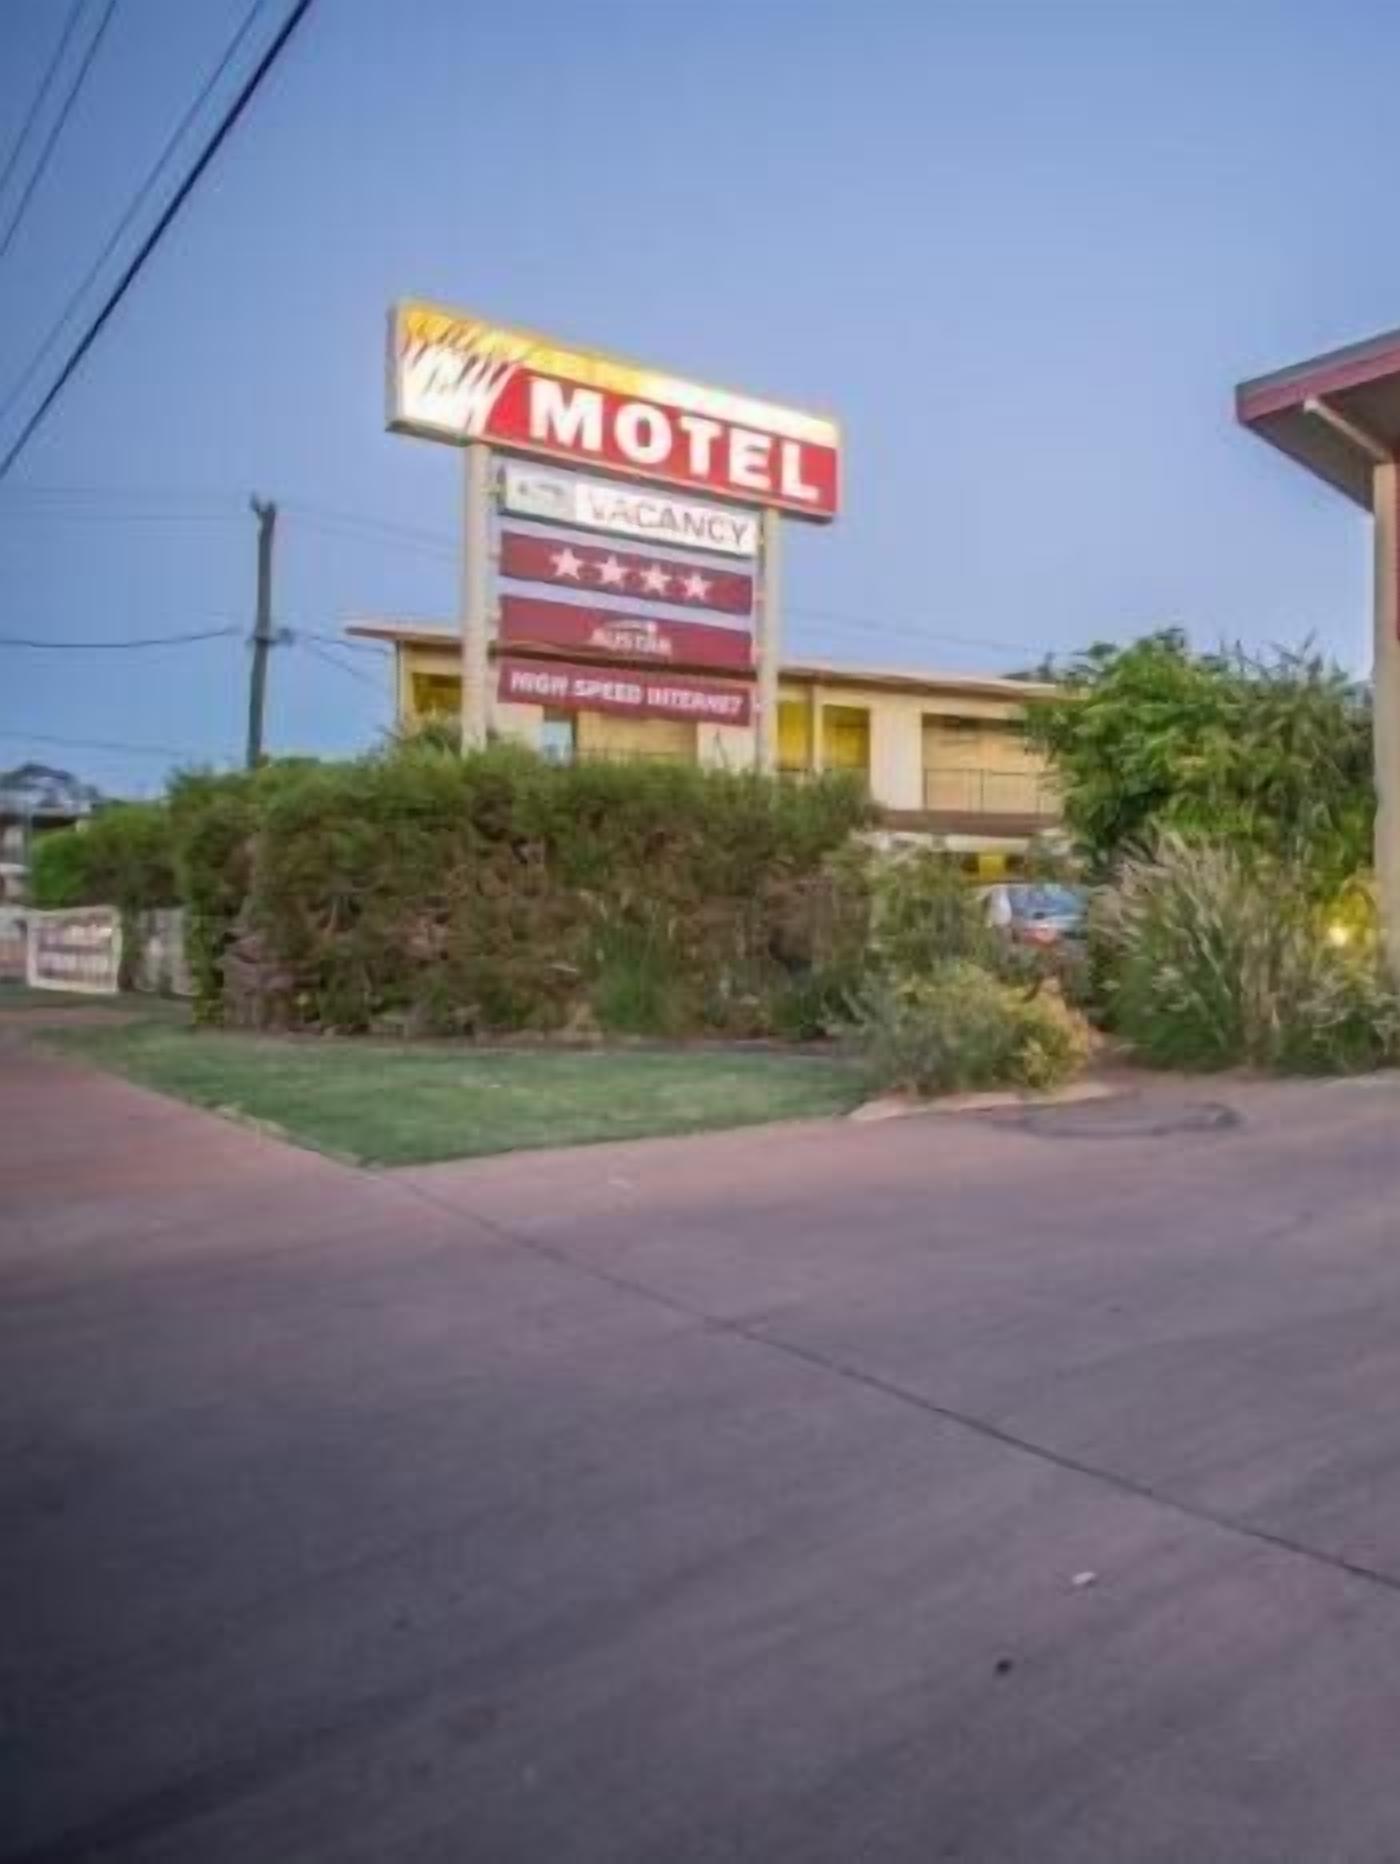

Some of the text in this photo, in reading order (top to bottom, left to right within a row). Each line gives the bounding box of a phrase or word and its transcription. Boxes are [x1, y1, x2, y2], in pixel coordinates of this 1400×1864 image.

[528, 375, 820, 502] MOTEL
[588, 493, 749, 545] VACANCY
[510, 671, 743, 716] HIGH SPEED INTERNET
